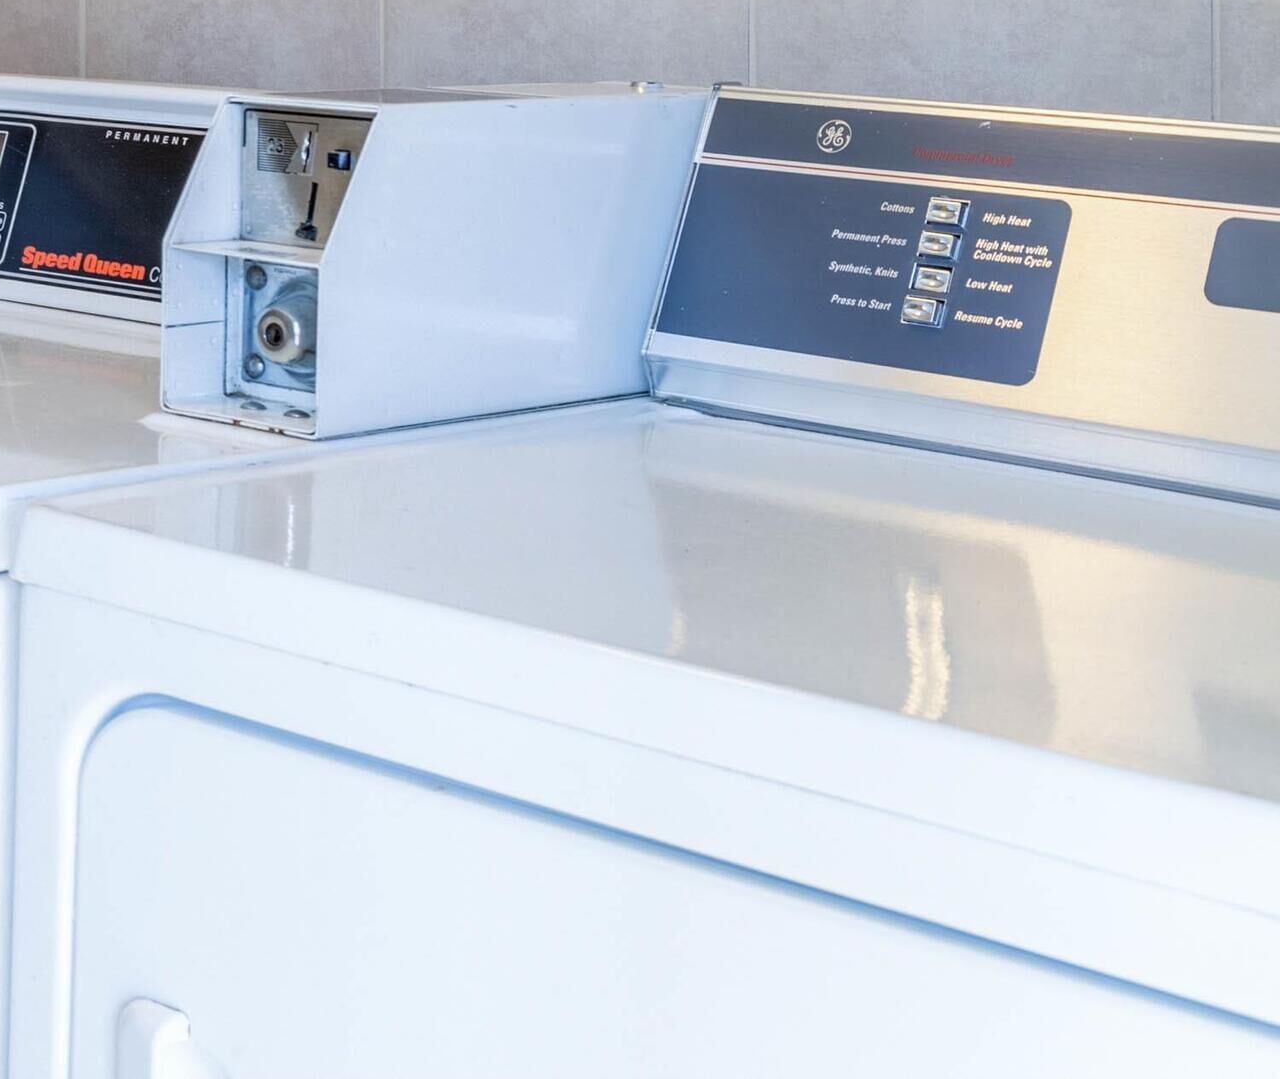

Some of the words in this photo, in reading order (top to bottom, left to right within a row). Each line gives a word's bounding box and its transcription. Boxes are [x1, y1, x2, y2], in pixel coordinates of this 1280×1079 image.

[105, 130, 189, 146] PERMANENT
[880, 201, 915, 214] Cottons
[982, 212, 1006, 226] High
[1007, 215, 1031, 227] Heat
[831, 228, 880, 243] Permanent
[880, 234, 908, 246] Press
[975, 238, 999, 252] High
[1000, 241, 1024, 253] Heat
[1025, 245, 1048, 256] with
[21, 245, 83, 270] Speed
[83, 253, 146, 280] Queen
[973, 250, 1022, 265] Cooldown
[1024, 255, 1053, 268] Cycle
[874, 266, 899, 278] Knits
[965, 278, 986, 290] Low
[988, 280, 1013, 293] Heat
[830, 294, 856, 307] Press
[857, 299, 867, 307] to
[868, 299, 892, 311] Start
[954, 310, 993, 325] Resume
[994, 316, 1024, 329] Cycle
